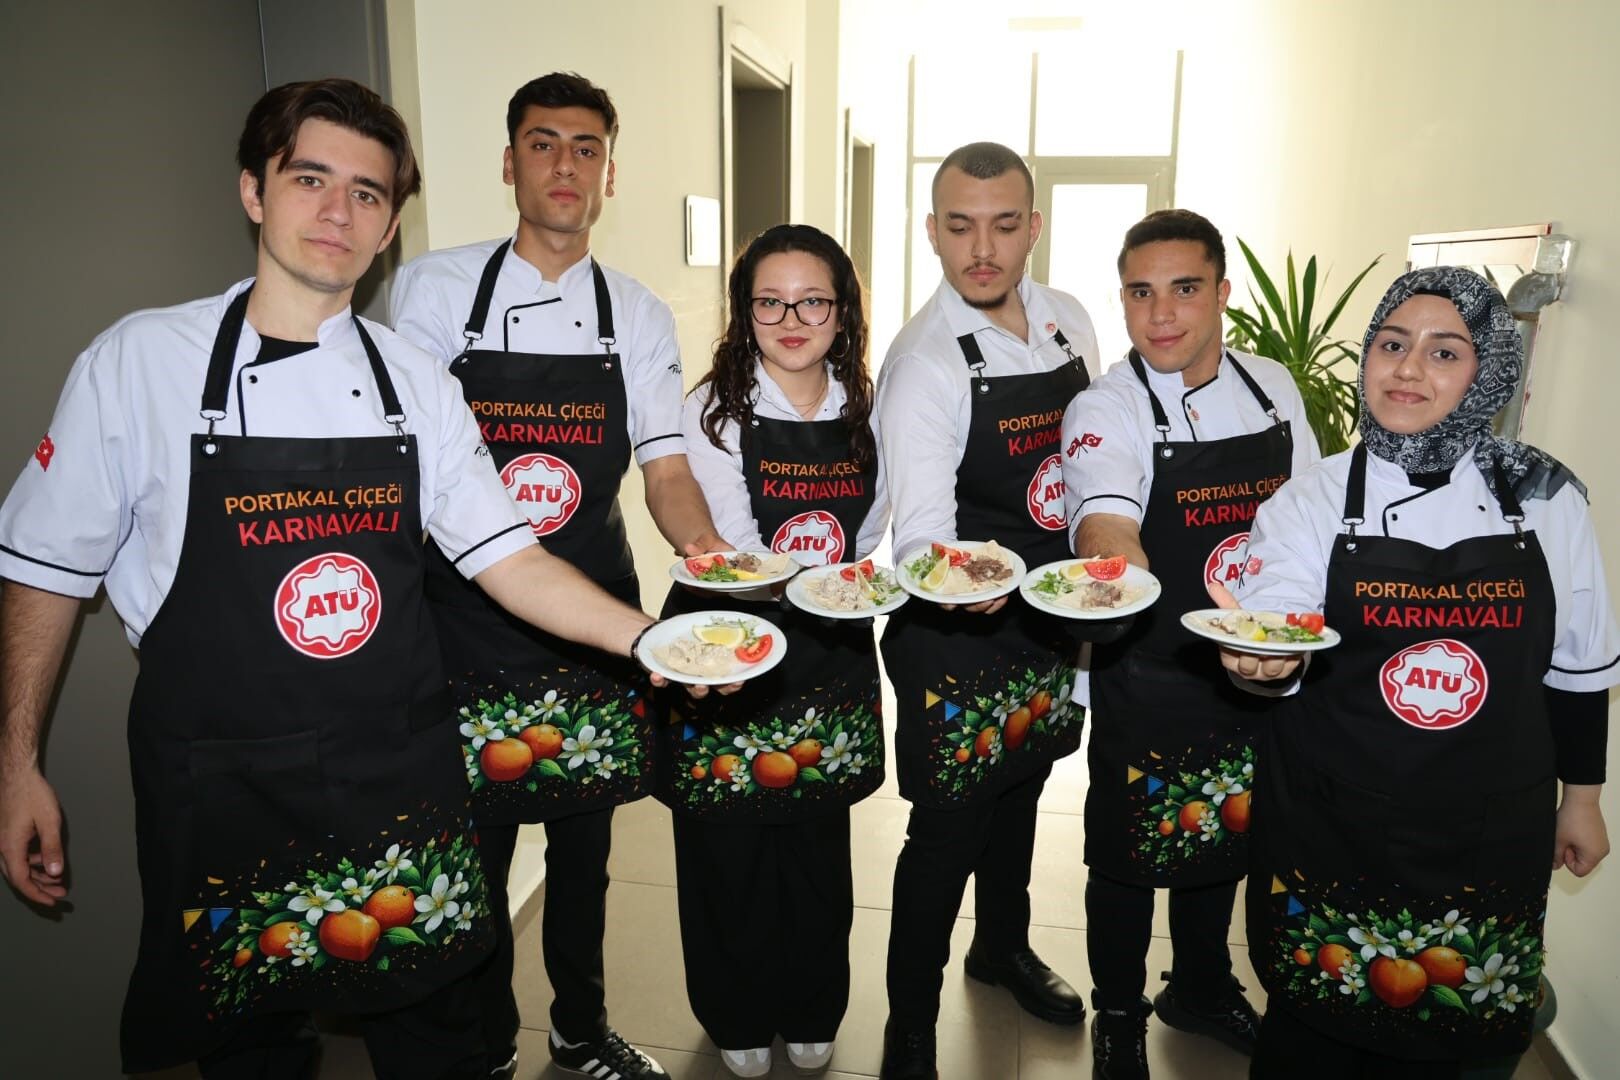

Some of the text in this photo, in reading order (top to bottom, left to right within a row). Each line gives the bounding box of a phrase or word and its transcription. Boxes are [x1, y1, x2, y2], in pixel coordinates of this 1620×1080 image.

[471, 401, 606, 421] PORTAKAL ÇİÇEĞİ
[478, 421, 604, 444] KARNAVALI
[1008, 426, 1064, 456] KARNA
[225, 483, 402, 515] PORTAKAL ÇİÇEĞİ
[763, 479, 864, 501] KARNAVALI
[1176, 482, 1254, 504] PORTAKAL
[1185, 500, 1259, 528] KARNA
[238, 511, 400, 547] KARNAVALI
[1355, 579, 1525, 602] PORTAKAL ÇİÇEĞİ
[1362, 605, 1524, 628] KARNAVALI
